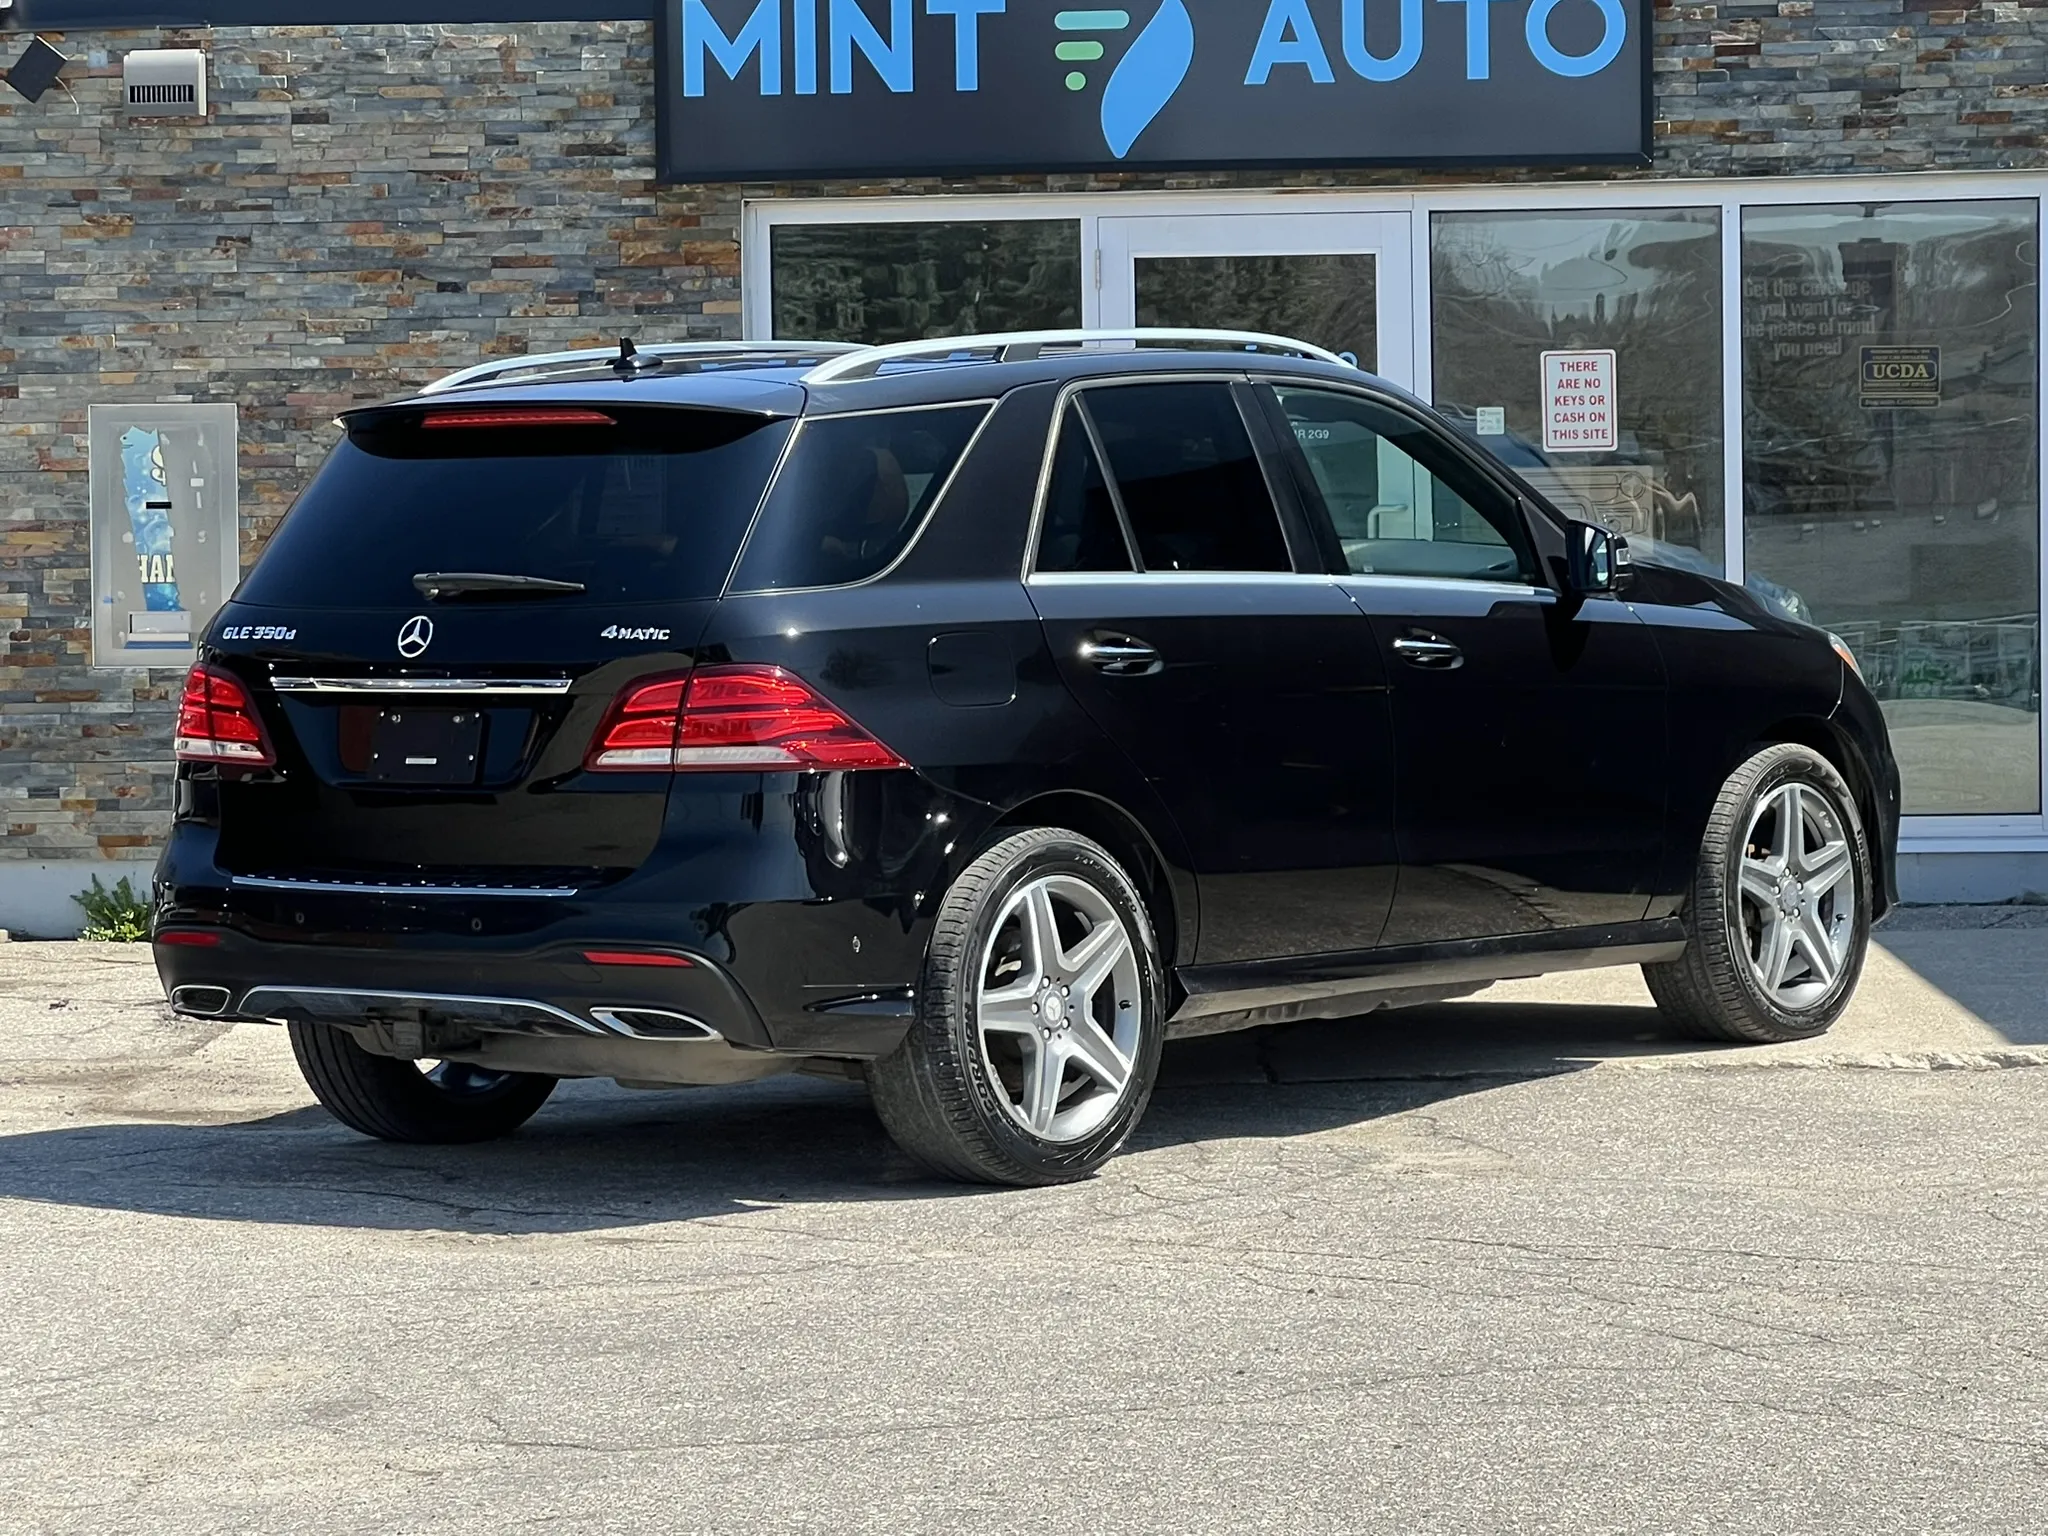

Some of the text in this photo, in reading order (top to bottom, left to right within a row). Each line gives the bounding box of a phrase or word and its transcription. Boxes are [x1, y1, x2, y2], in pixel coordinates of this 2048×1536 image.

[682, 0, 1628, 98] MINT AUTO
[1800, 280, 1871, 300] coveage
[1559, 361, 1598, 372] THERE
[1871, 363, 1929, 379] UCDA
[1557, 378, 1601, 389] ARE NO
[1554, 395, 1605, 406] KEYS OR
[1554, 412, 1606, 423] CASH ON
[1308, 429, 1329, 439] 2G9
[1552, 428, 1608, 440] THIS SITE
[222, 626, 297, 640] GLE 350d
[600, 624, 671, 640] 4MATIC
